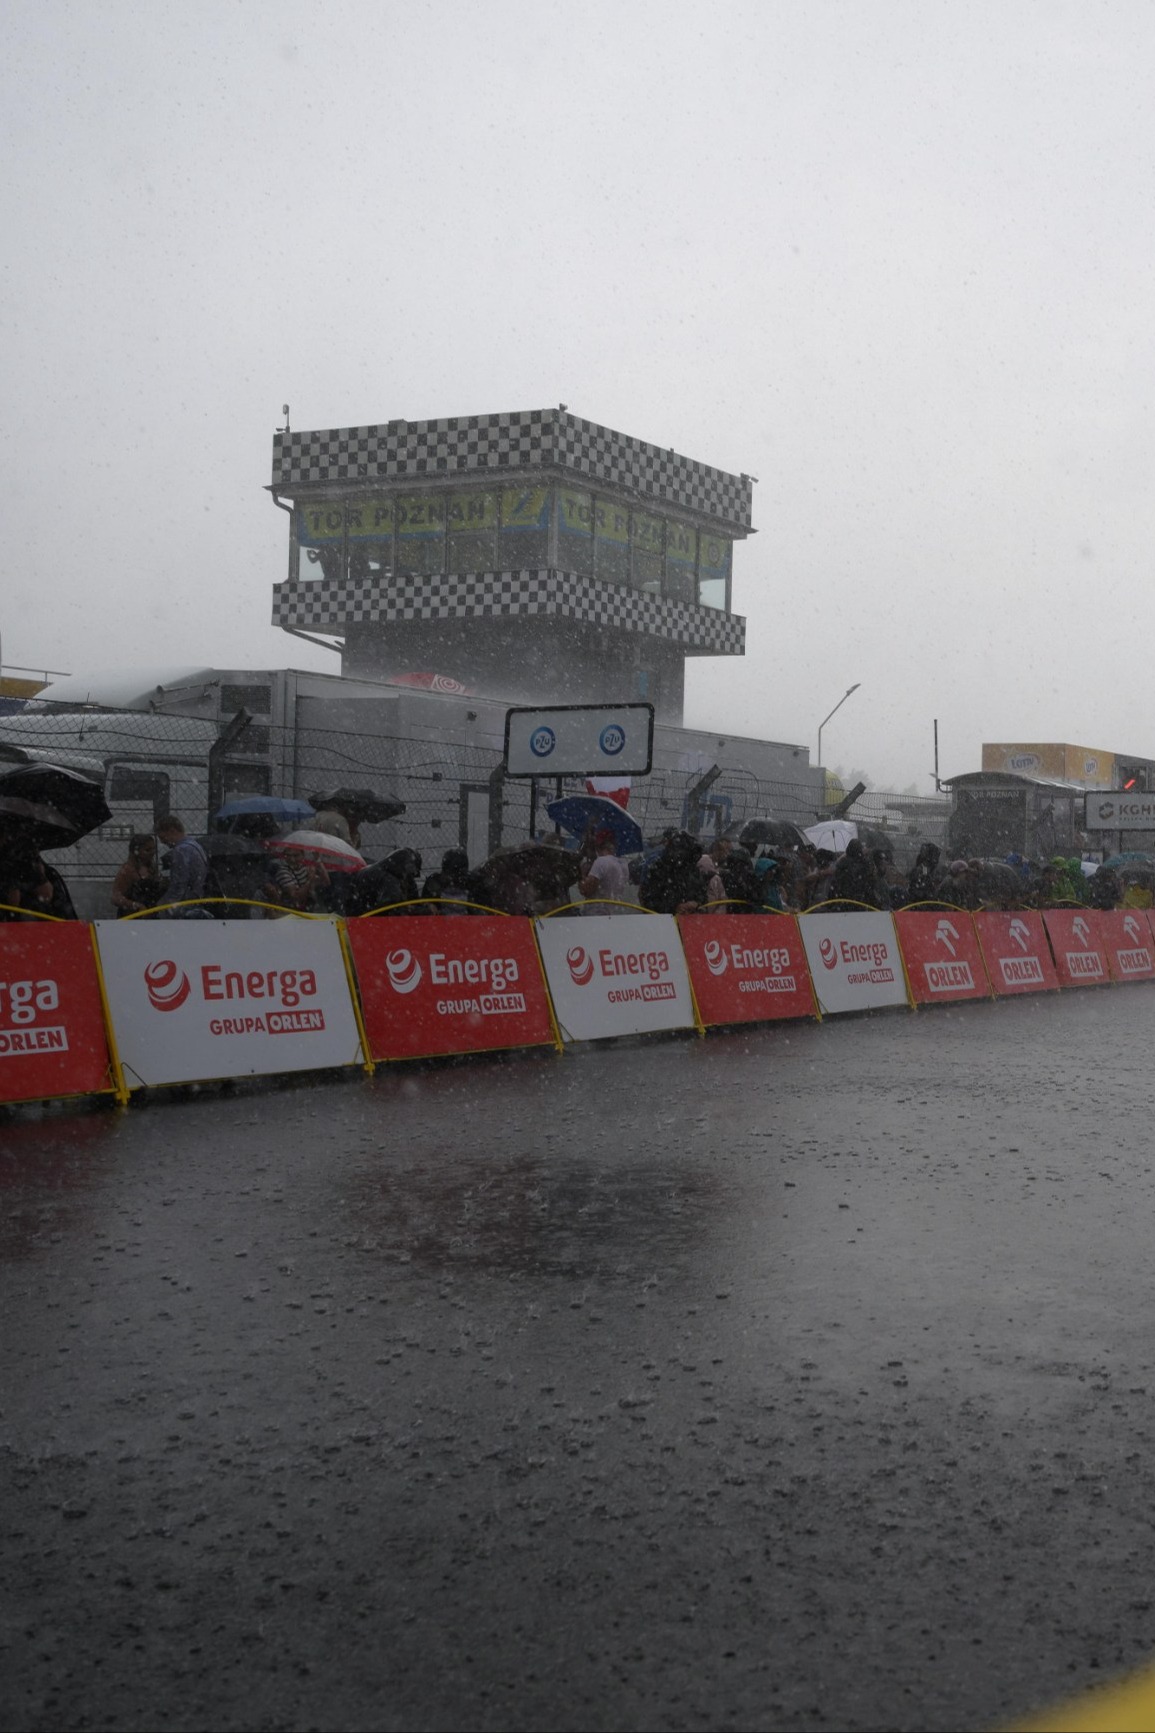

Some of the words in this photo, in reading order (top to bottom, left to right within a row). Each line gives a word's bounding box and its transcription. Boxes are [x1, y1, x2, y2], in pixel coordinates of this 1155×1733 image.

[309, 509, 363, 530] TOR
[565, 499, 606, 529] TOR
[601, 947, 669, 981] Energa
[730, 943, 791, 975] Energa
[840, 941, 888, 966] Energa
[1069, 955, 1101, 975] ORLEN
[1121, 952, 1151, 972] ORLEN
[430, 953, 519, 991] Energa
[847, 973, 871, 985] GRUPA
[871, 969, 893, 983] ORLEN
[928, 965, 971, 988] ORLEN
[1003, 960, 1040, 982] ORLEN
[202, 964, 318, 1007] Energa
[607, 989, 642, 1003] GRUPA
[642, 984, 674, 1000] ORLEN
[738, 980, 766, 993] GRUPA
[767, 978, 794, 991] ORLEN
[436, 998, 480, 1015] GRUPA
[482, 993, 524, 1013] ORLEN
[210, 1016, 266, 1036] GRUPA
[269, 1010, 322, 1032] ORLEN
[0, 1030, 64, 1054] ORLEN
